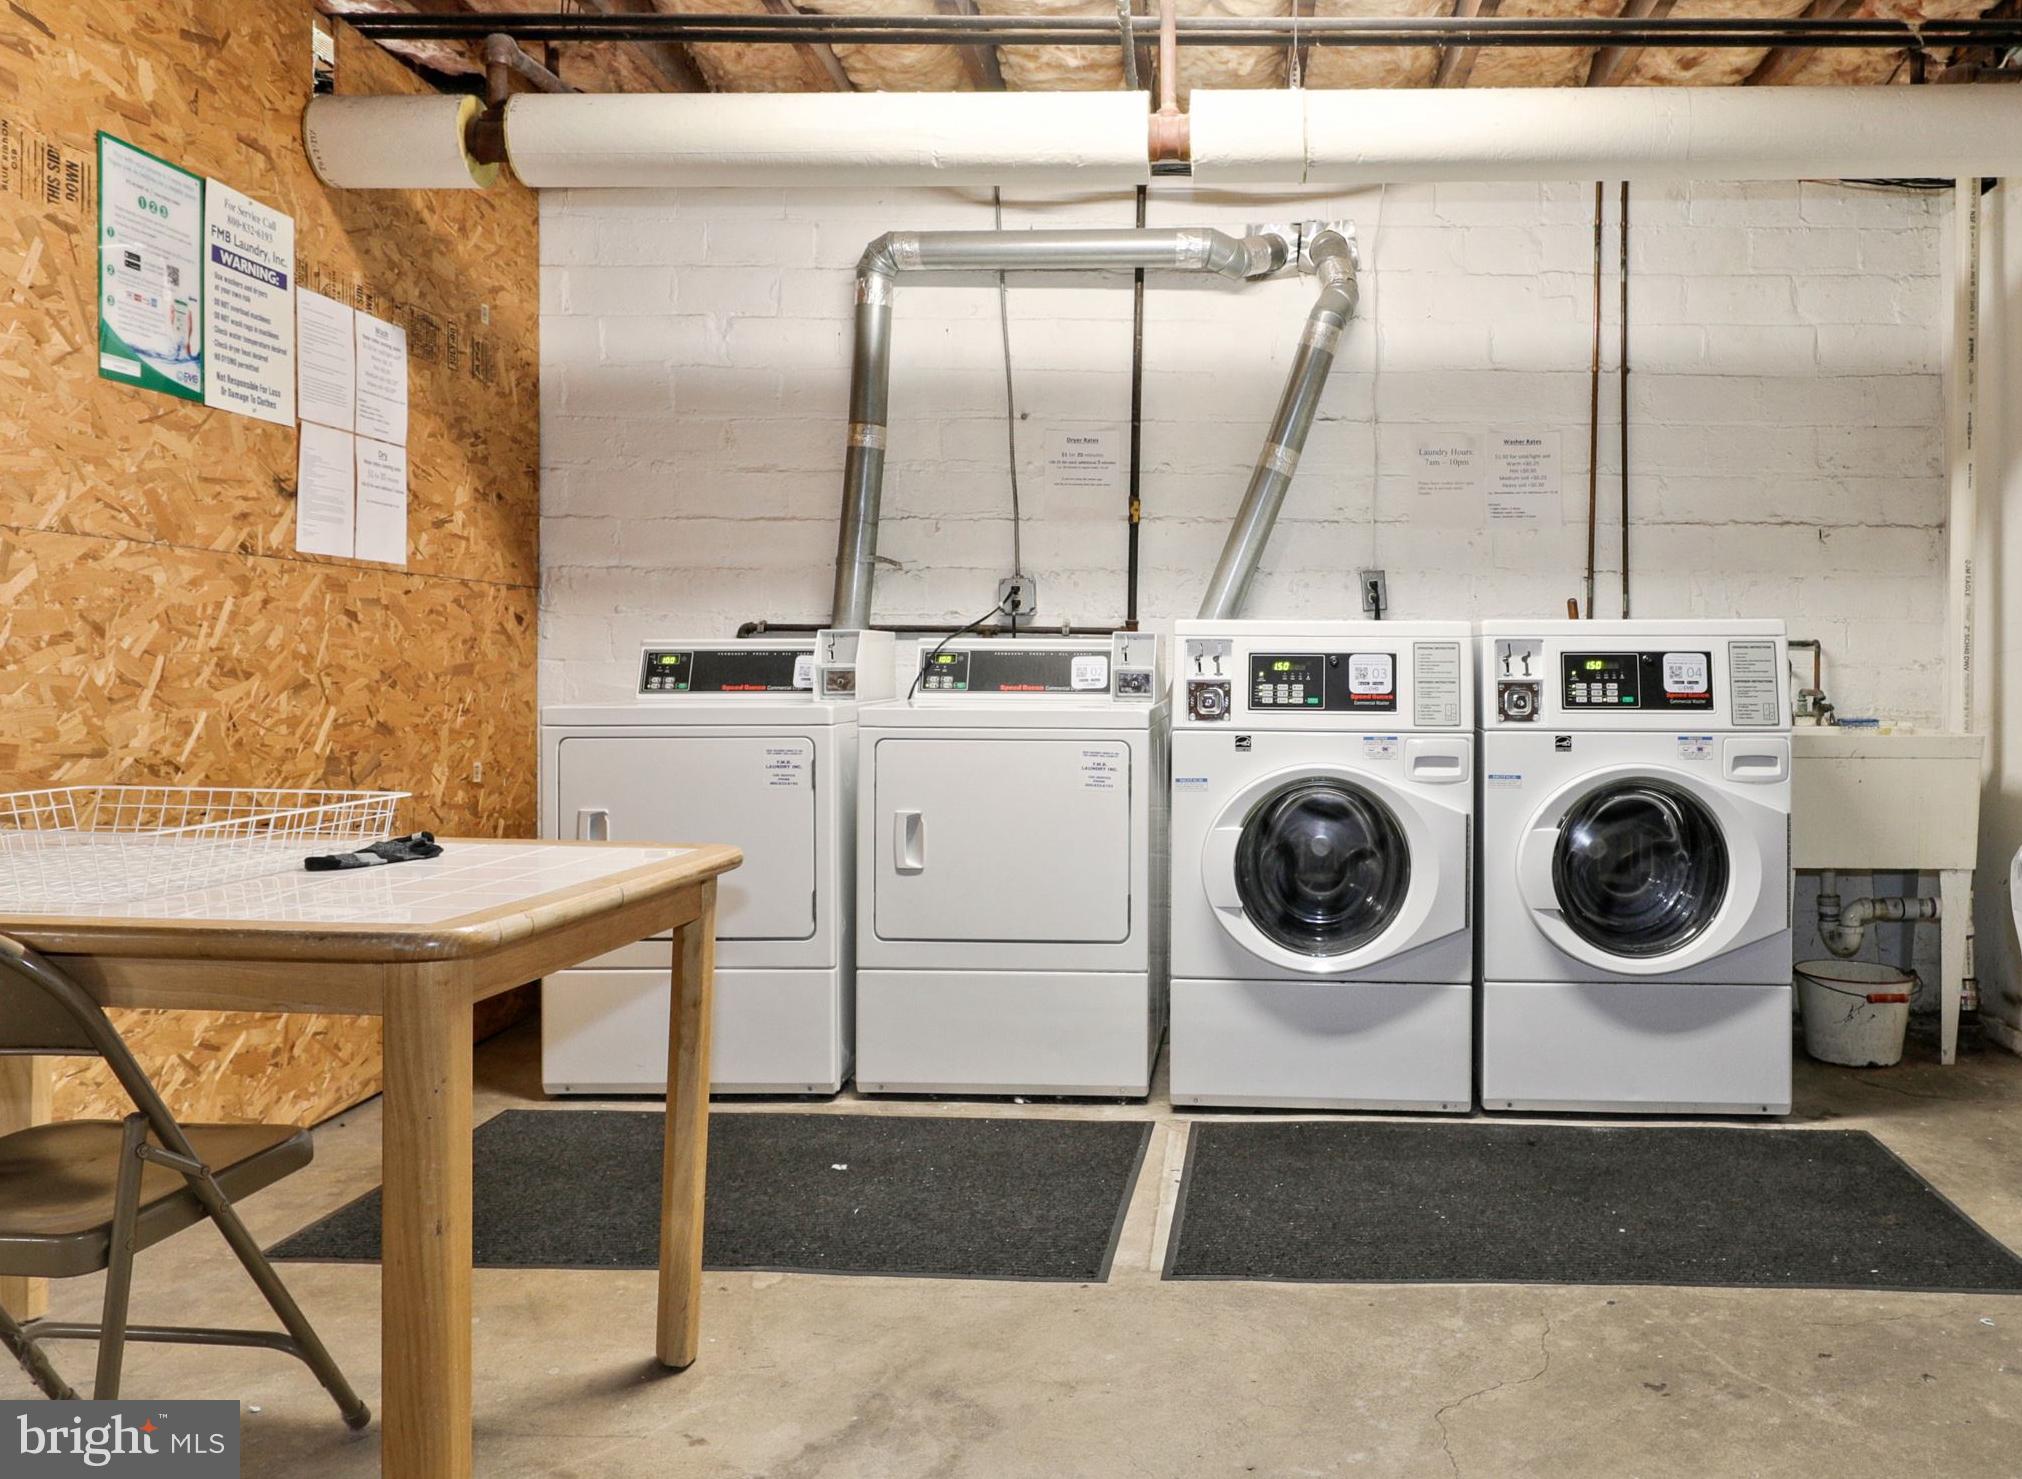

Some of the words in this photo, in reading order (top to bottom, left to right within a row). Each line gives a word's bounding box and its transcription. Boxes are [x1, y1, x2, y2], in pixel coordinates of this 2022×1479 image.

[0, 165, 9, 191] BLUE
[46, 175, 61, 205] THIS
[224, 199, 236, 212] For
[236, 206, 260, 224] Service
[262, 216, 276, 232] Call
[211, 224, 231, 243] FMB
[273, 251, 288, 268] Inc.
[220, 249, 280, 286] WARNING:
[216, 371, 226, 382] Not
[227, 374, 258, 392] Responsible
[260, 383, 268, 394] For
[269, 387, 281, 398] Loss
[221, 386, 227, 396] Or
[228, 388, 249, 403] Damage
[250, 394, 256, 404] To
[257, 395, 277, 409] Clothes
[378, 450, 388, 462] Dry
[1418, 448, 1448, 457] Laundry
[1450, 458, 1470, 468] 10pm
[1091, 668, 1103, 677] 02
[1372, 668, 1388, 680] 03
[1686, 667, 1702, 678] 04
